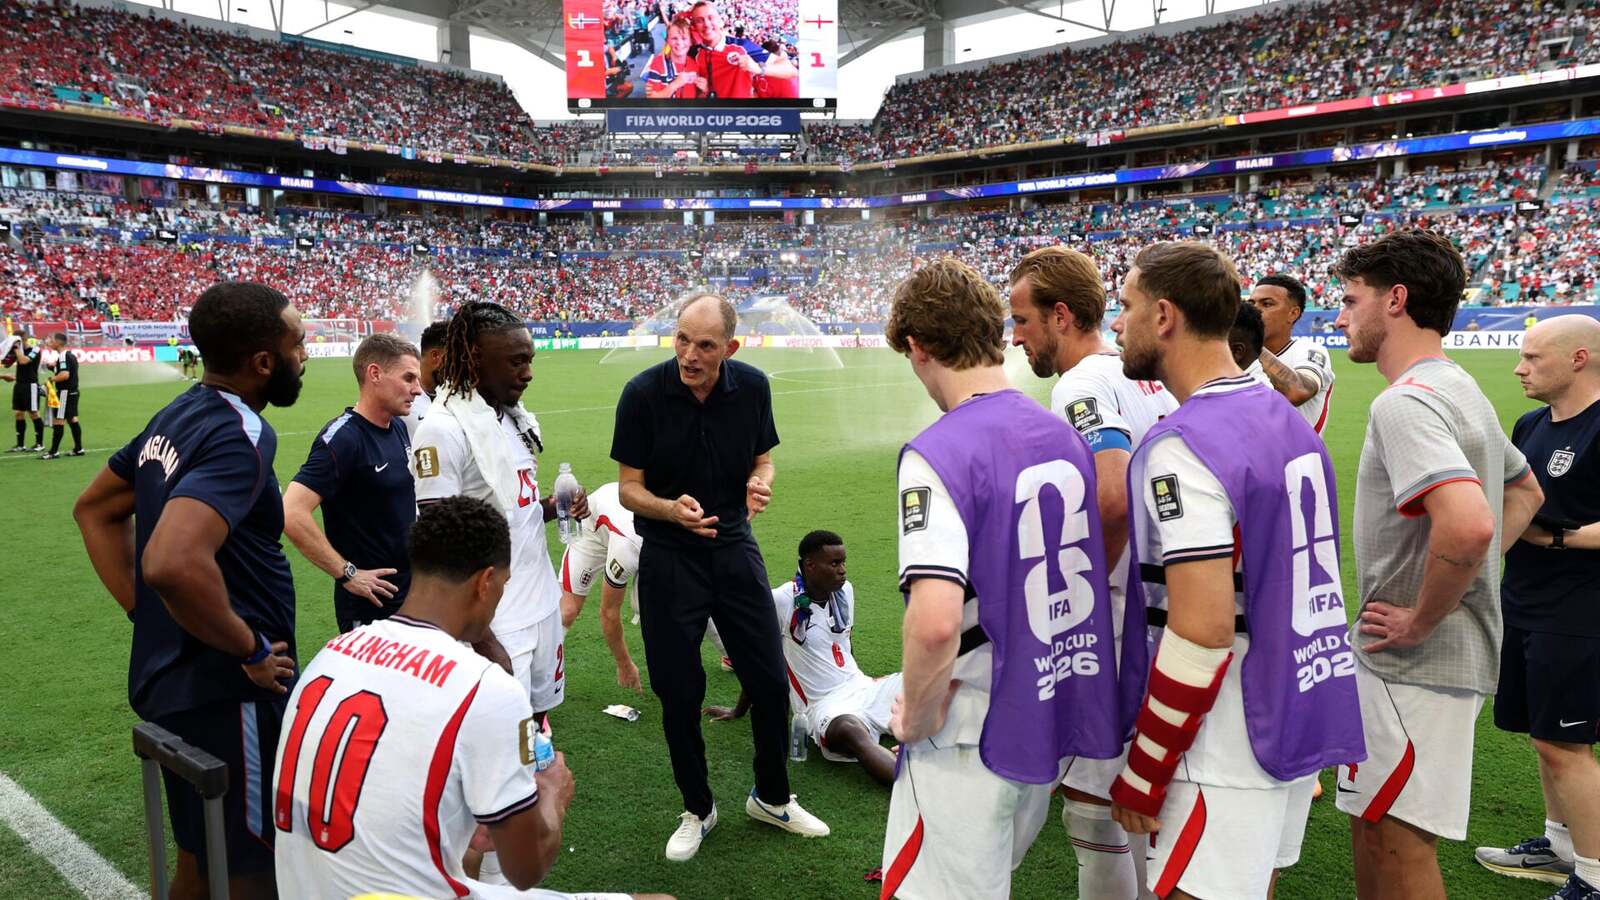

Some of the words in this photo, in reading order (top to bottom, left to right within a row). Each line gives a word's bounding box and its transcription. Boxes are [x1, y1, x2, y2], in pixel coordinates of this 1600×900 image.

[577, 50, 594, 67] 1
[810, 52, 825, 68] 1
[626, 115, 654, 126] FIFA
[656, 115, 705, 126] WORLD
[707, 115, 733, 126] CUP
[735, 115, 782, 126] 2026
[1235, 157, 1273, 169] MIAMI
[280, 176, 314, 189] MIAMI
[1017, 182, 1036, 192] FIFA
[1036, 179, 1066, 190] WORLD
[1067, 177, 1085, 187] CUP
[593, 200, 621, 208] MIAMI
[902, 193, 927, 203] MIAMI
[532, 327, 547, 335] FIFA
[784, 337, 822, 347] verizon
[839, 337, 880, 347] verzon
[1454, 334, 1519, 347] BANK
[40, 349, 151, 363] MDonald's
[1049, 599, 1071, 621] IFA
[1309, 592, 1344, 617] IFA
[1065, 633, 1098, 651] CUP
[1293, 635, 1341, 664] WORLD
[327, 630, 457, 688] ELLINGHAM
[832, 642, 845, 668] 6
[1036, 651, 1100, 702] 226
[1297, 651, 1355, 693] 202
[275, 674, 389, 853] 10
